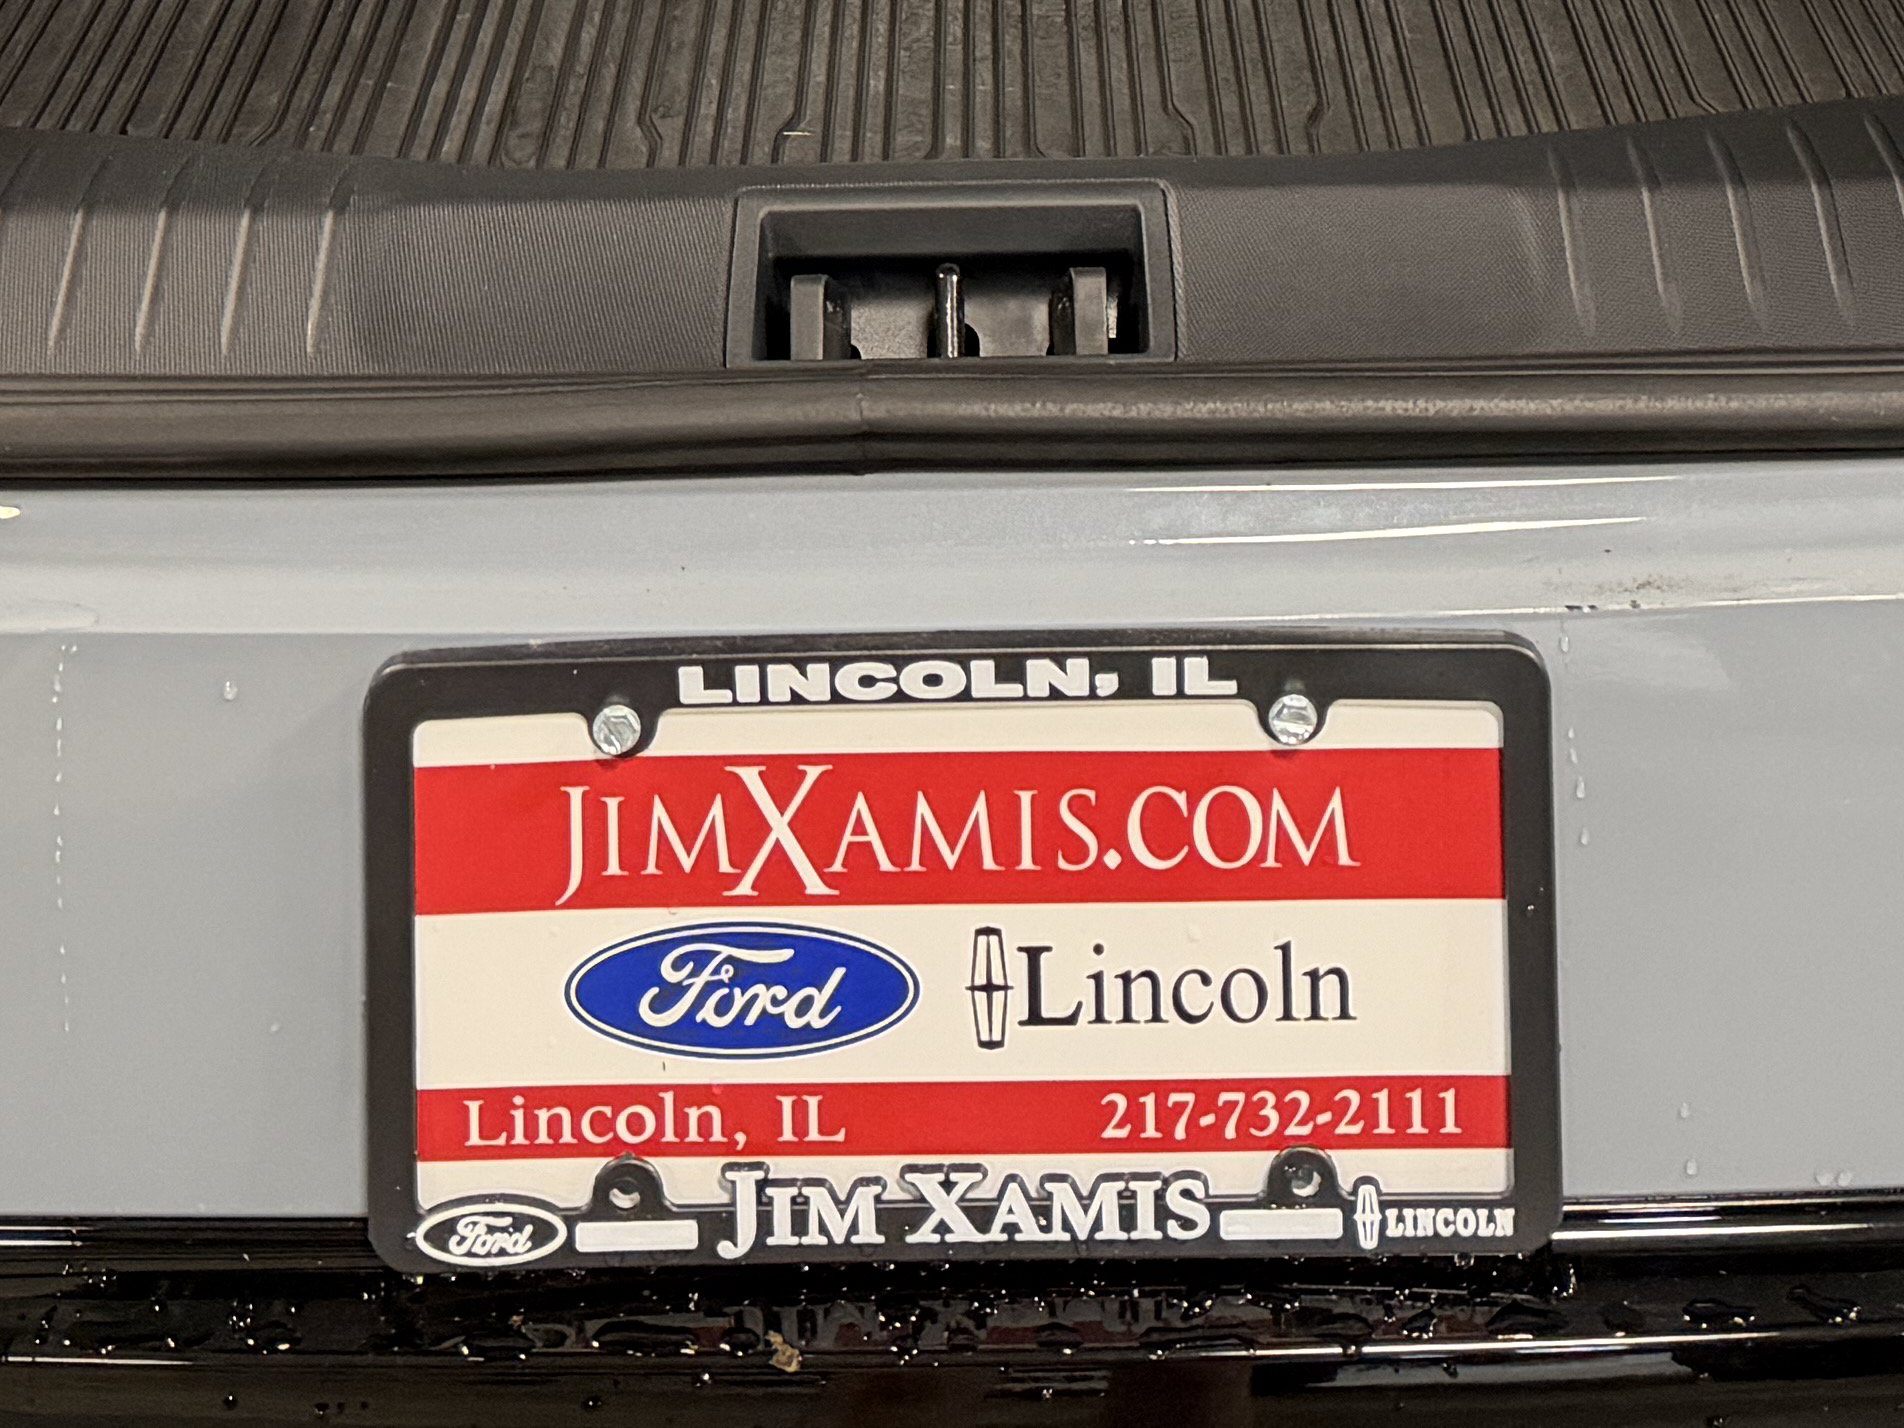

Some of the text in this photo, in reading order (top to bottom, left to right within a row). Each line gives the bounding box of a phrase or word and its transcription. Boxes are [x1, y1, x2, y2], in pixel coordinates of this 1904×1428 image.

[678, 657, 1237, 704] LINCOLN, IL
[556, 764, 1361, 905] JIMXAMIS.COM
[639, 943, 844, 1030] Ford
[1017, 941, 1357, 1026] Lincoln
[463, 1094, 846, 1150] Lincoln, IL
[1099, 1087, 1462, 1141] 217-732-2111
[448, 1215, 532, 1255] Ford
[717, 1170, 1210, 1259] JIM XAMIS
[1385, 1207, 1515, 1238] LINCOLN
